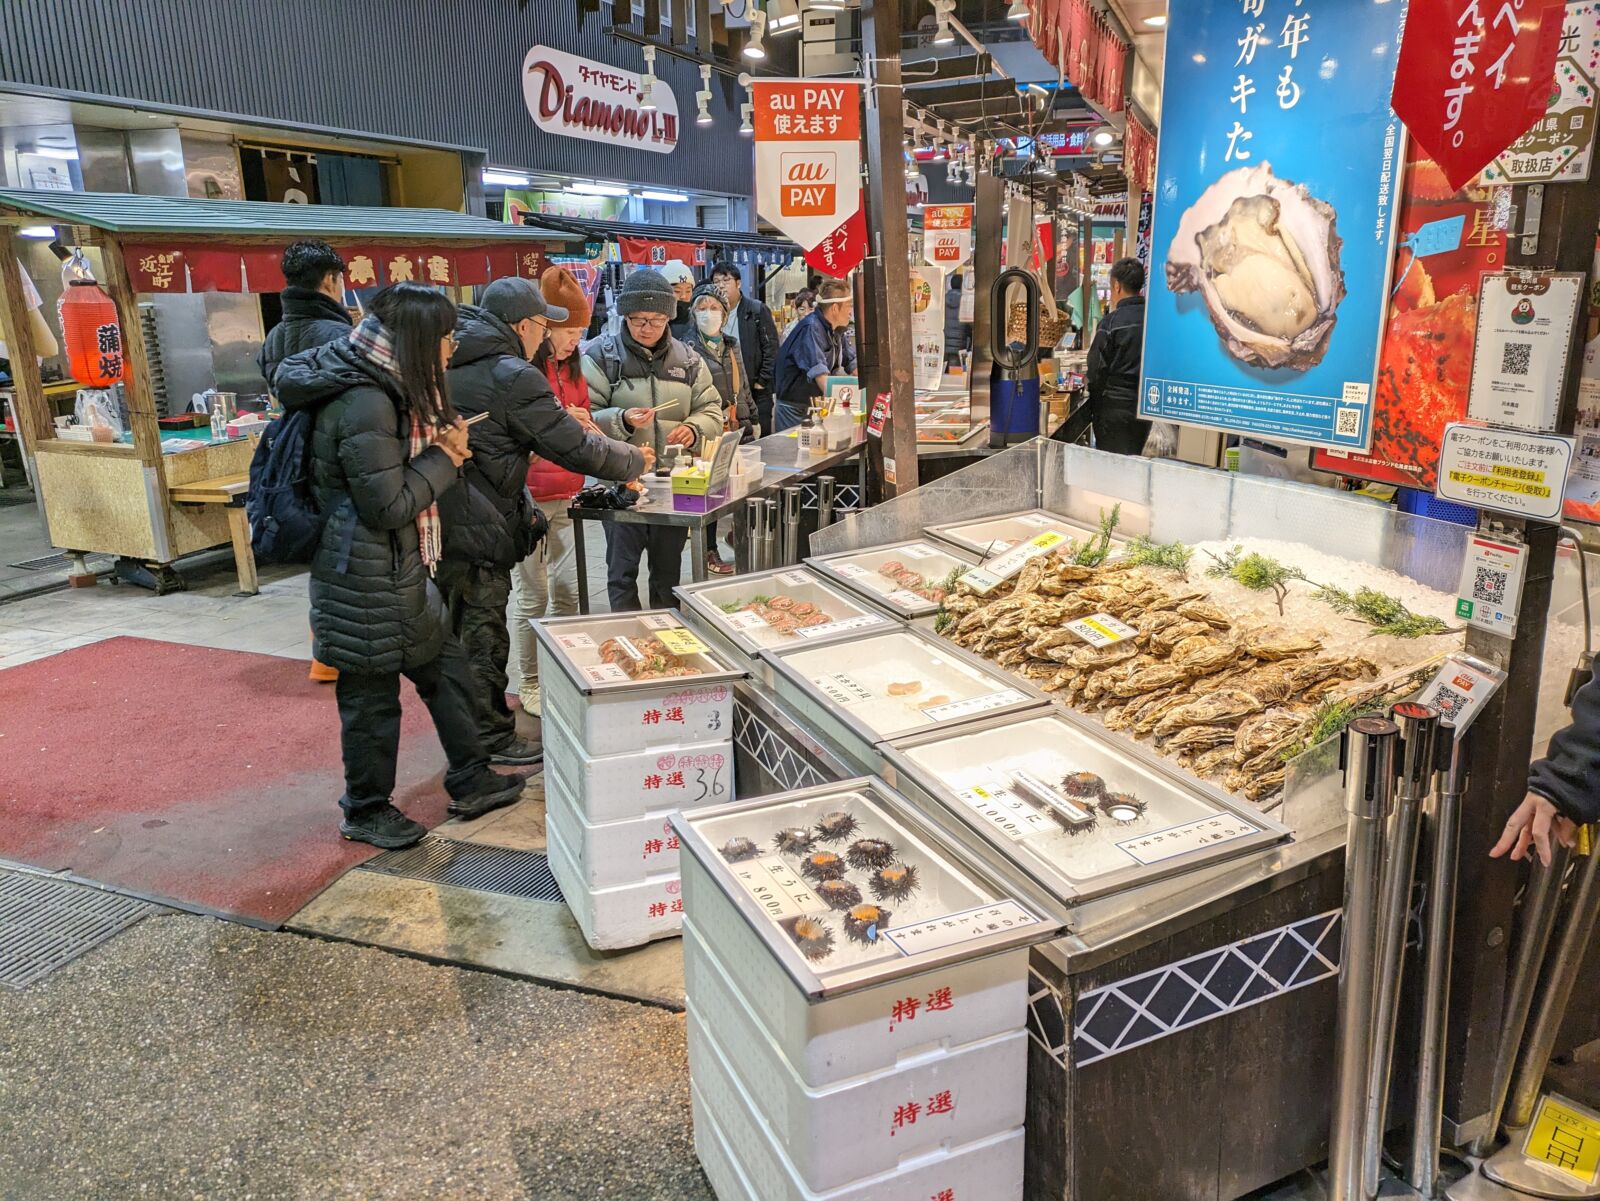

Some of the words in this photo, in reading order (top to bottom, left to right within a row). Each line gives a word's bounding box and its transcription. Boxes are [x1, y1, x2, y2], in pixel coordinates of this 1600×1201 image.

[1276, 0, 1310, 109] 年も
[1485, 0, 1523, 90] ペイ
[770, 94, 796, 109] au
[804, 89, 844, 110] PAY
[774, 114, 842, 135] 使えます
[1526, 118, 1558, 133] 川県
[1508, 133, 1573, 149] 光クーポン
[788, 163, 830, 181] au
[1511, 158, 1553, 174] 取扱店
[1376, 124, 1396, 245] 全国翌日配送致します。
[791, 188, 826, 206] PAY
[835, 225, 848, 252] ペイ
[822, 234, 838, 270] ます。
[939, 248, 955, 256] PAY
[97, 323, 123, 378] 蒲焼
[1451, 433, 1563, 456] 電子クーポンをご利用のお客様へ
[1456, 447, 1548, 469] ご協力をお願いいたします。
[1466, 488, 1526, 506] を行ってください。
[643, 707, 684, 725] 特選
[644, 772, 685, 790] 特選
[991, 789, 1042, 823] 生うに
[768, 865, 811, 902] 生うに
[753, 886, 783, 915] 800円
[894, 909, 1002, 939] 召し上がれます
[972, 915, 1030, 936] その場で
[891, 987, 954, 1022] 特選
[893, 1090, 955, 1127] 特選
[1546, 1126, 1584, 1170] 出口
